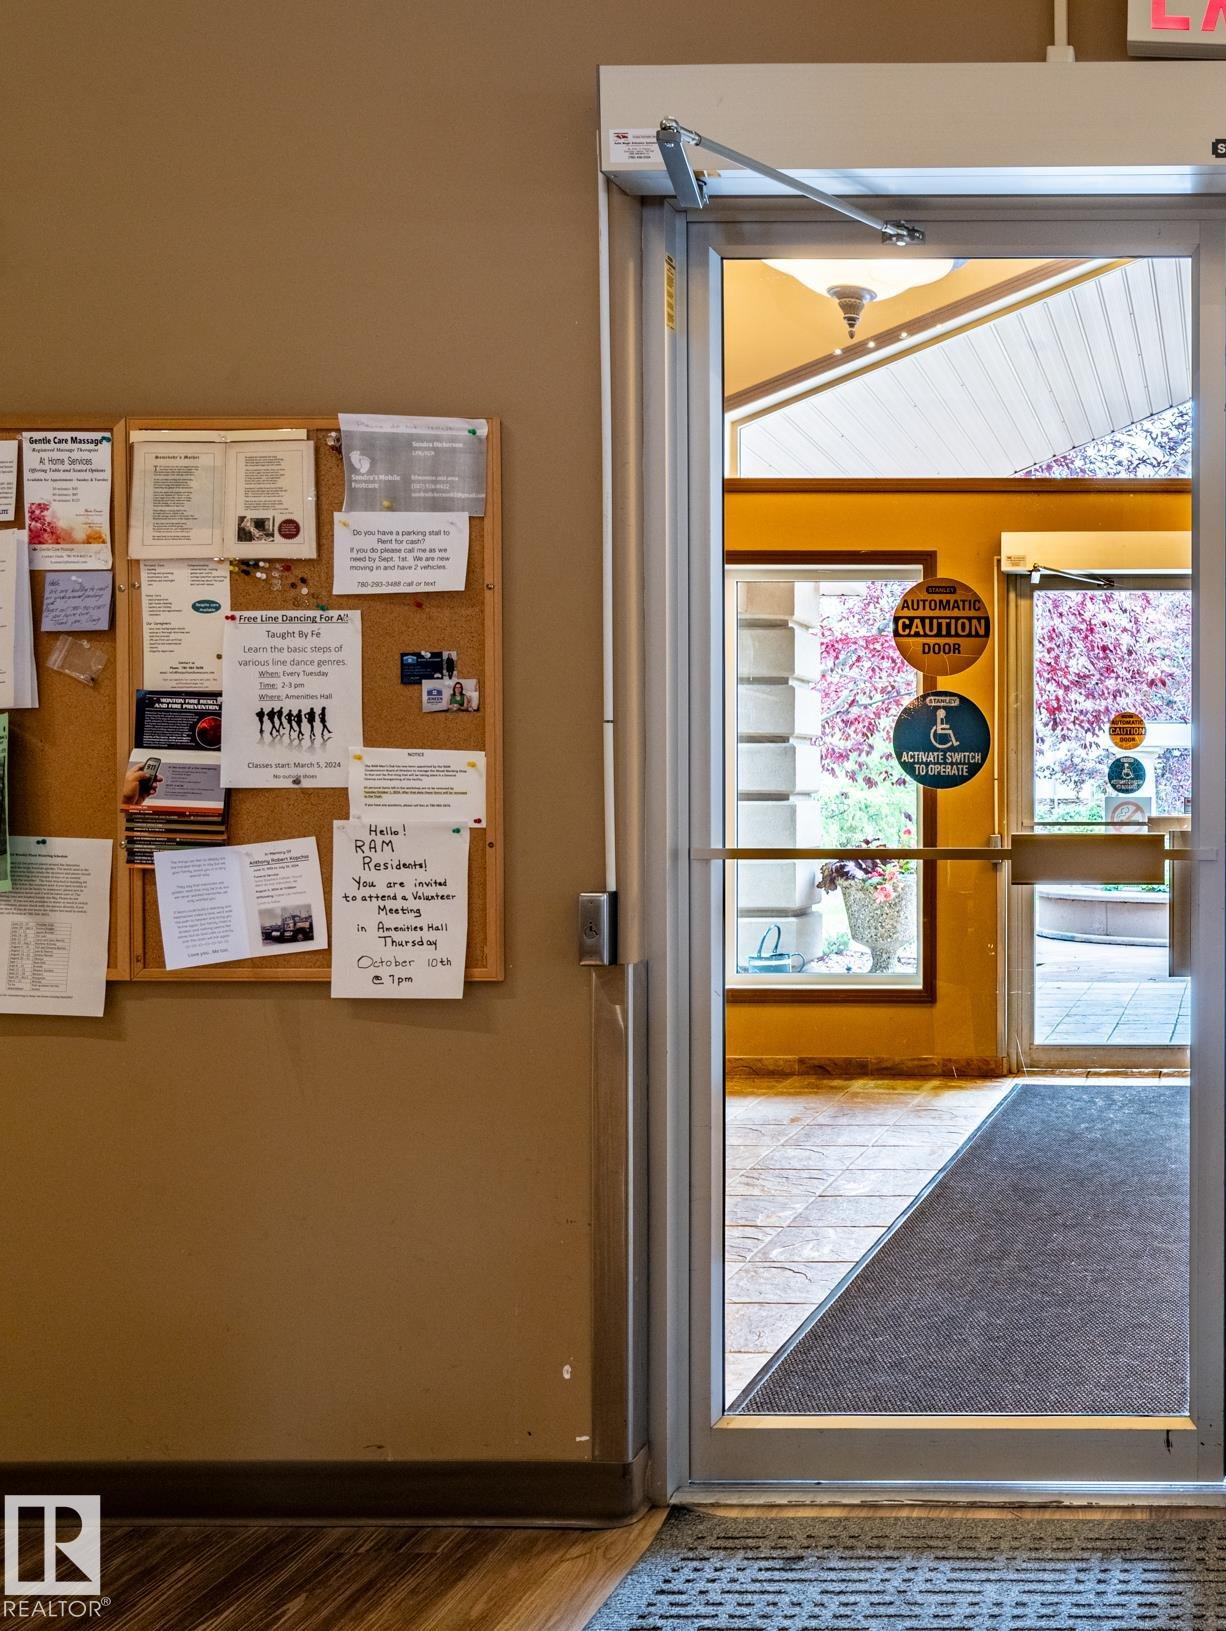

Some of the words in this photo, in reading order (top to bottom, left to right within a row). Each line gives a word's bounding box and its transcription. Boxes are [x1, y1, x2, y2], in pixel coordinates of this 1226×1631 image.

[29, 436, 52, 445] Gentle
[53, 437, 68, 445] Care
[70, 436, 103, 446] Massage
[39, 457, 45, 465] At
[48, 457, 65, 466] Home
[68, 457, 93, 466] Services
[401, 529, 426, 538] parking
[380, 547, 402, 555] please
[901, 599, 981, 611] AUTOMATIC
[239, 614, 258, 622] Free
[261, 614, 279, 622] Line
[282, 614, 317, 623] Dancing
[320, 614, 334, 622] For
[898, 619, 985, 635] CAUTION
[266, 630, 295, 639] Taught
[298, 630, 308, 639] By
[311, 628, 321, 638] Fé
[270, 645, 285, 653] the
[287, 645, 308, 653] basic
[310, 645, 331, 654] steps
[334, 645, 343, 653] of
[922, 643, 961, 655] DOOR
[238, 659, 270, 667] various
[272, 659, 288, 667] line
[317, 659, 347, 668] genres.
[258, 693, 283, 701] Where:
[901, 752, 943, 763] ACTIVATE
[946, 752, 981, 763] SWITCH
[914, 765, 925, 775] TO
[928, 765, 968, 776] OPERATE
[354, 839, 395, 854] RAM
[362, 856, 428, 871] Residents!
[352, 876, 376, 890] You
[414, 878, 447, 888] invited
[342, 893, 356, 902] to
[361, 893, 397, 901] attend
[412, 892, 456, 901] Volunteer
[378, 905, 421, 918] Meeting
[357, 924, 366, 933] in
[377, 921, 424, 933] Amenities
[427, 923, 448, 932] Hall
[378, 936, 437, 951] Thursday
[357, 955, 415, 969] October
[427, 957, 451, 967] 10th
[372, 975, 384, 985] @
